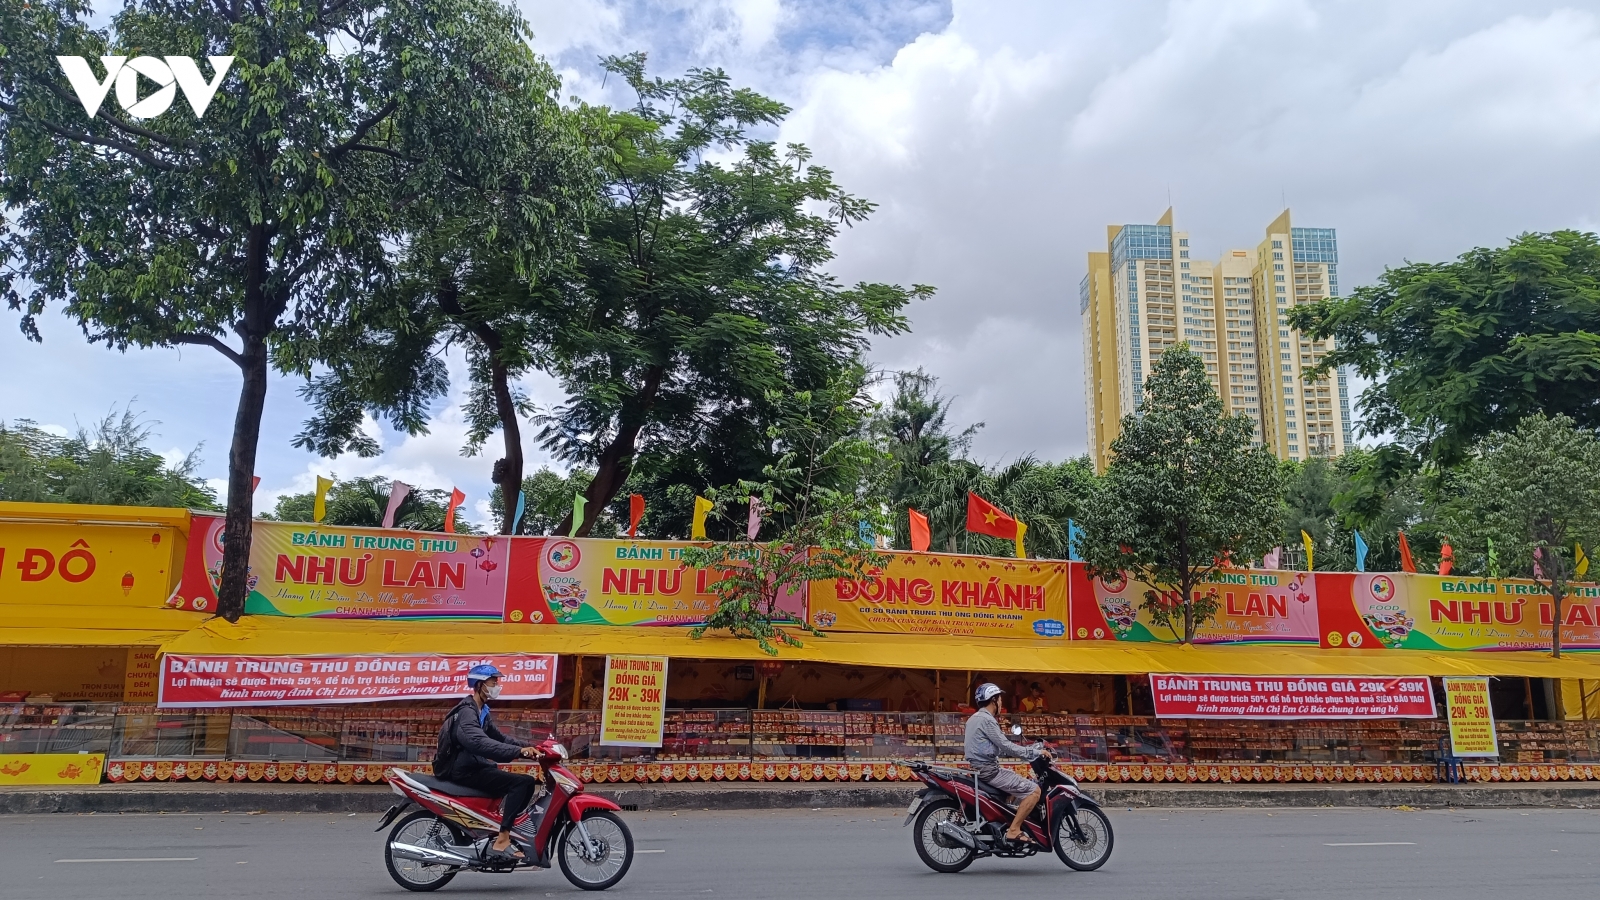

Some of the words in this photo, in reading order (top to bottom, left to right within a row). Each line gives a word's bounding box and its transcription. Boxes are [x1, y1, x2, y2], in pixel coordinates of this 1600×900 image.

[292, 531, 347, 547] BÁNH
[353, 536, 414, 551] TRUNG
[422, 539, 457, 552] THU
[616, 544, 662, 560] BÁNH
[17, 538, 96, 583] ĐÔ
[275, 553, 373, 586] NHƯ
[382, 559, 466, 590] LAN
[602, 564, 688, 596] NHƯ
[1249, 574, 1279, 586] THU
[835, 567, 935, 605] ĐỒNG
[941, 576, 1045, 611] KHÁNH
[1441, 580, 1497, 594] BÁNH
[1502, 583, 1568, 596] TRU
[1574, 587, 1600, 598] TH
[1225, 592, 1288, 618] LAN
[1429, 597, 1526, 627] NHƯ
[1538, 641, 1562, 649] HI
[134, 652, 155, 660] SÁNG
[170, 659, 229, 673] BÁNH
[235, 661, 303, 673] TRUNG
[310, 661, 348, 673] THU
[354, 658, 411, 672] ĐỒNG
[417, 658, 450, 672] GIÁ
[513, 659, 548, 671] 39K
[610, 658, 628, 670] BÁNH
[629, 660, 650, 671] TRUNG
[651, 661, 663, 672] THU
[172, 677, 187, 688] Lợi
[190, 677, 222, 688] nhuận
[225, 677, 238, 686] sẽ
[241, 677, 267, 688] được
[270, 677, 295, 685] trích
[297, 677, 321, 686] 50%
[325, 674, 340, 685] để
[341, 675, 355, 685] hỗ
[357, 675, 372, 685] trợ
[375, 674, 400, 684] khắc
[403, 675, 429, 685] phục
[431, 673, 450, 684] hậu
[453, 674, 468, 683] qu
[501, 673, 521, 682] BÃO
[524, 674, 545, 682] YAGI
[616, 671, 640, 685] ĐỒNG
[642, 674, 656, 686] GIÁ
[1157, 678, 1199, 691] BÁNH
[1202, 681, 1251, 692] TRUNG
[1255, 681, 1283, 692] THU
[1287, 679, 1327, 692] ĐỒNG
[1331, 680, 1356, 692] GIÁ
[1359, 682, 1386, 692] 29K
[1399, 682, 1425, 692] 39K
[220, 687, 249, 698] Kính
[251, 690, 285, 699] mong
[287, 687, 313, 697] Anh
[316, 687, 336, 698] Chị
[338, 687, 358, 696] Em
[361, 684, 377, 694] Cô
[378, 684, 400, 695] Bác
[400, 684, 439, 695] chung
[441, 683, 462, 694] tay
[1447, 681, 1461, 692] BÁNH
[1460, 682, 1477, 692] TRUNG
[1477, 682, 1487, 692] THU
[608, 687, 630, 701] 29K
[640, 688, 661, 703] 39K
[1160, 694, 1172, 703] Lợi
[1173, 694, 1197, 703] nhuận
[1199, 694, 1208, 702] sẽ
[1210, 694, 1229, 704] được
[1230, 695, 1249, 703] trích
[1250, 695, 1268, 703] 50%
[1270, 693, 1280, 703] để
[1281, 694, 1291, 703] hỗ
[1292, 695, 1303, 704] trợ
[1305, 694, 1323, 703] khắc
[1325, 696, 1344, 705] phục
[1345, 695, 1359, 704] hậu
[1361, 695, 1374, 704] quả
[1376, 695, 1392, 703] SIÊU
[1394, 694, 1409, 703] BÃO
[1409, 695, 1425, 703] YAGI
[1454, 693, 1472, 705] ĐỒNG
[1473, 694, 1485, 705] GIÁ
[1196, 704, 1218, 713] Kính
[1219, 706, 1245, 715] mong
[1246, 705, 1264, 713] Anh
[1266, 705, 1280, 715] Chị
[1281, 705, 1296, 713] Em
[1298, 704, 1309, 713] Cô
[1310, 704, 1326, 713] Bác
[1327, 705, 1354, 715] chung
[1355, 706, 1369, 714] tay
[1370, 705, 1387, 715] ủng
[1388, 705, 1399, 715] hộ
[1451, 706, 1467, 718] 29K
[1473, 706, 1490, 718] 39K
